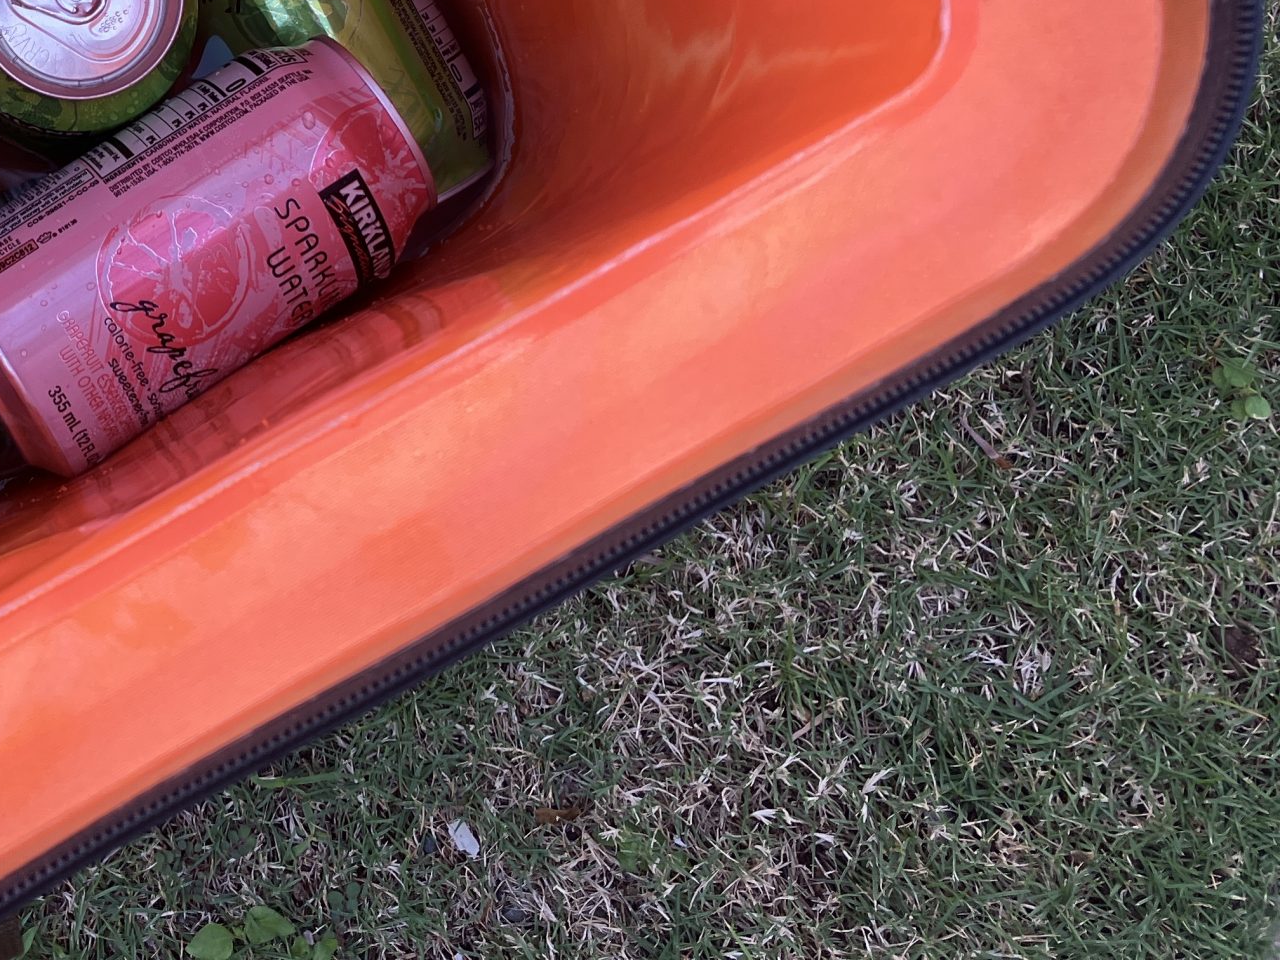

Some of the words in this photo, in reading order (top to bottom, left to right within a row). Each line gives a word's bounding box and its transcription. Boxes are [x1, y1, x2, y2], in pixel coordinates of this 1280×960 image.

[145, 127, 188, 157] CARBONATED
[186, 112, 212, 131] WATER,
[210, 93, 240, 115] NATURAL
[151, 148, 173, 165] COSTCO
[171, 128, 203, 152] WHOLESALE
[55, 306, 104, 376] GRAPEFRUIT
[101, 313, 153, 389] calorie-free
[46, 383, 72, 414] 355
[56, 343, 86, 378] WITH
[76, 373, 104, 411] OTHER
[61, 409, 83, 433] mL
[70, 427, 93, 449] (12
